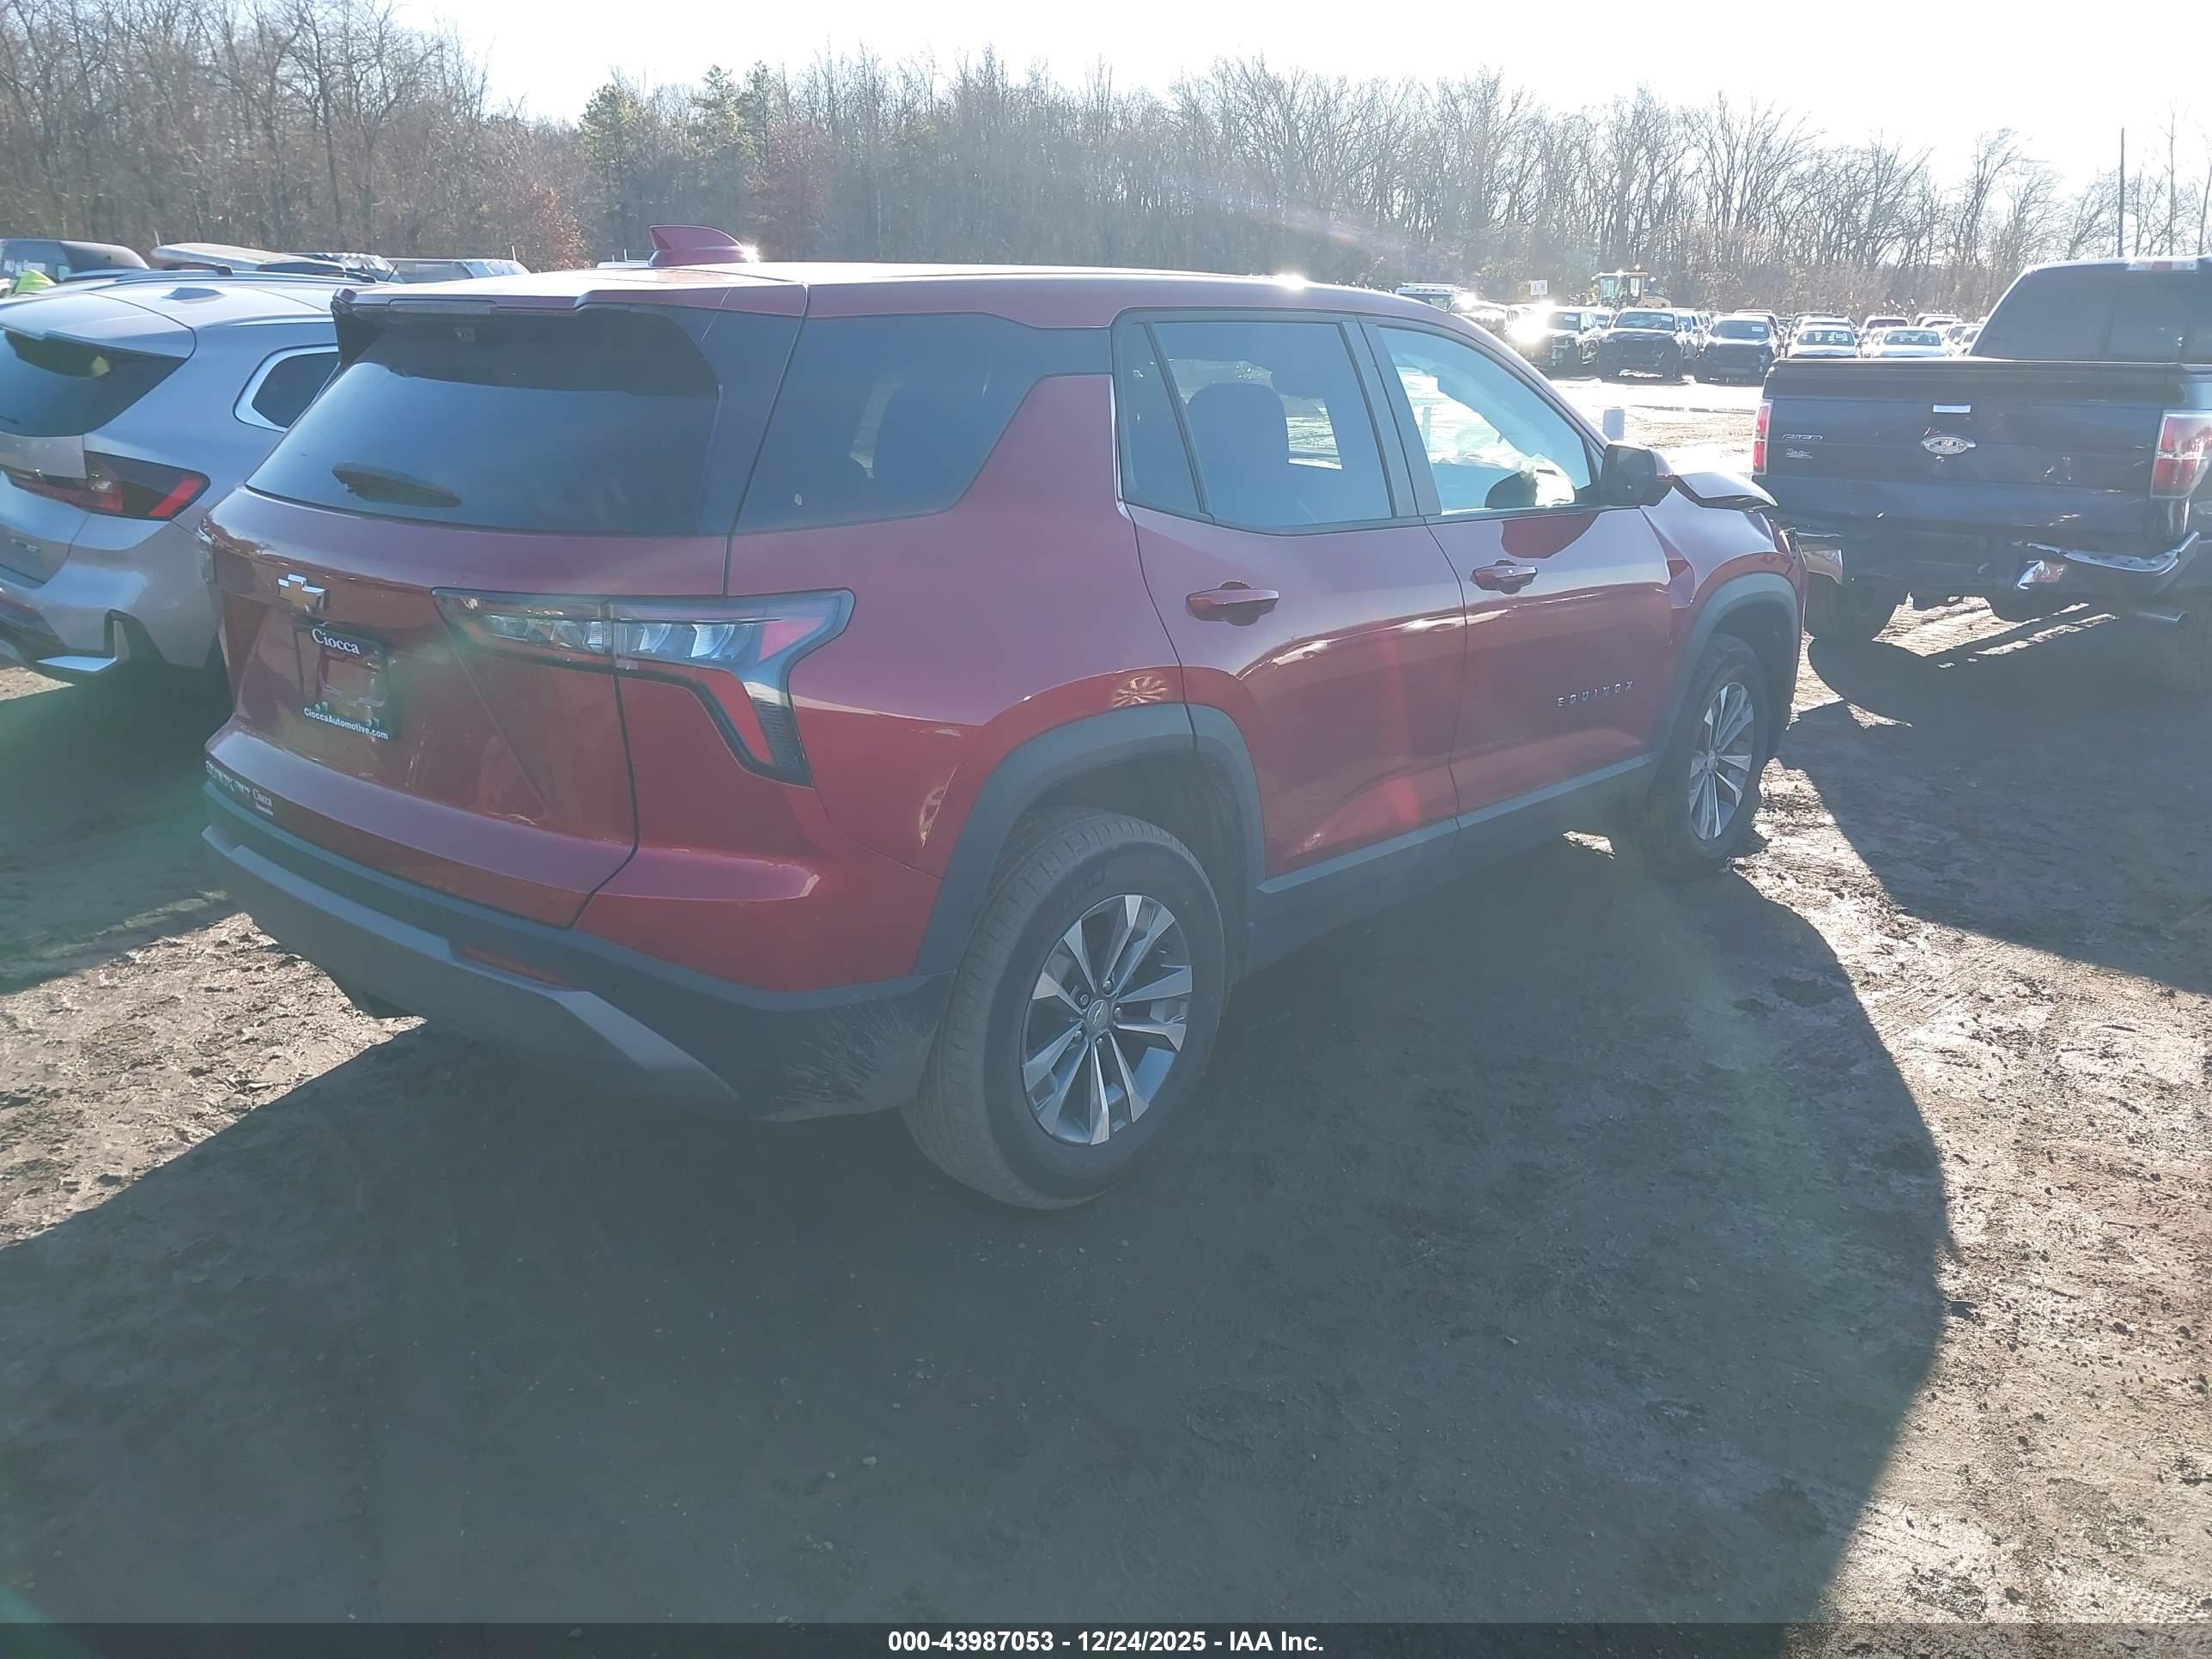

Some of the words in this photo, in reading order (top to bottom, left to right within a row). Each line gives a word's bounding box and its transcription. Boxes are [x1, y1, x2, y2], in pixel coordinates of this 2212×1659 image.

[312, 629, 361, 654] Ciocca
[1558, 680, 1634, 708] EQUINOX
[303, 707, 389, 740] CioccaAutomotive.com
